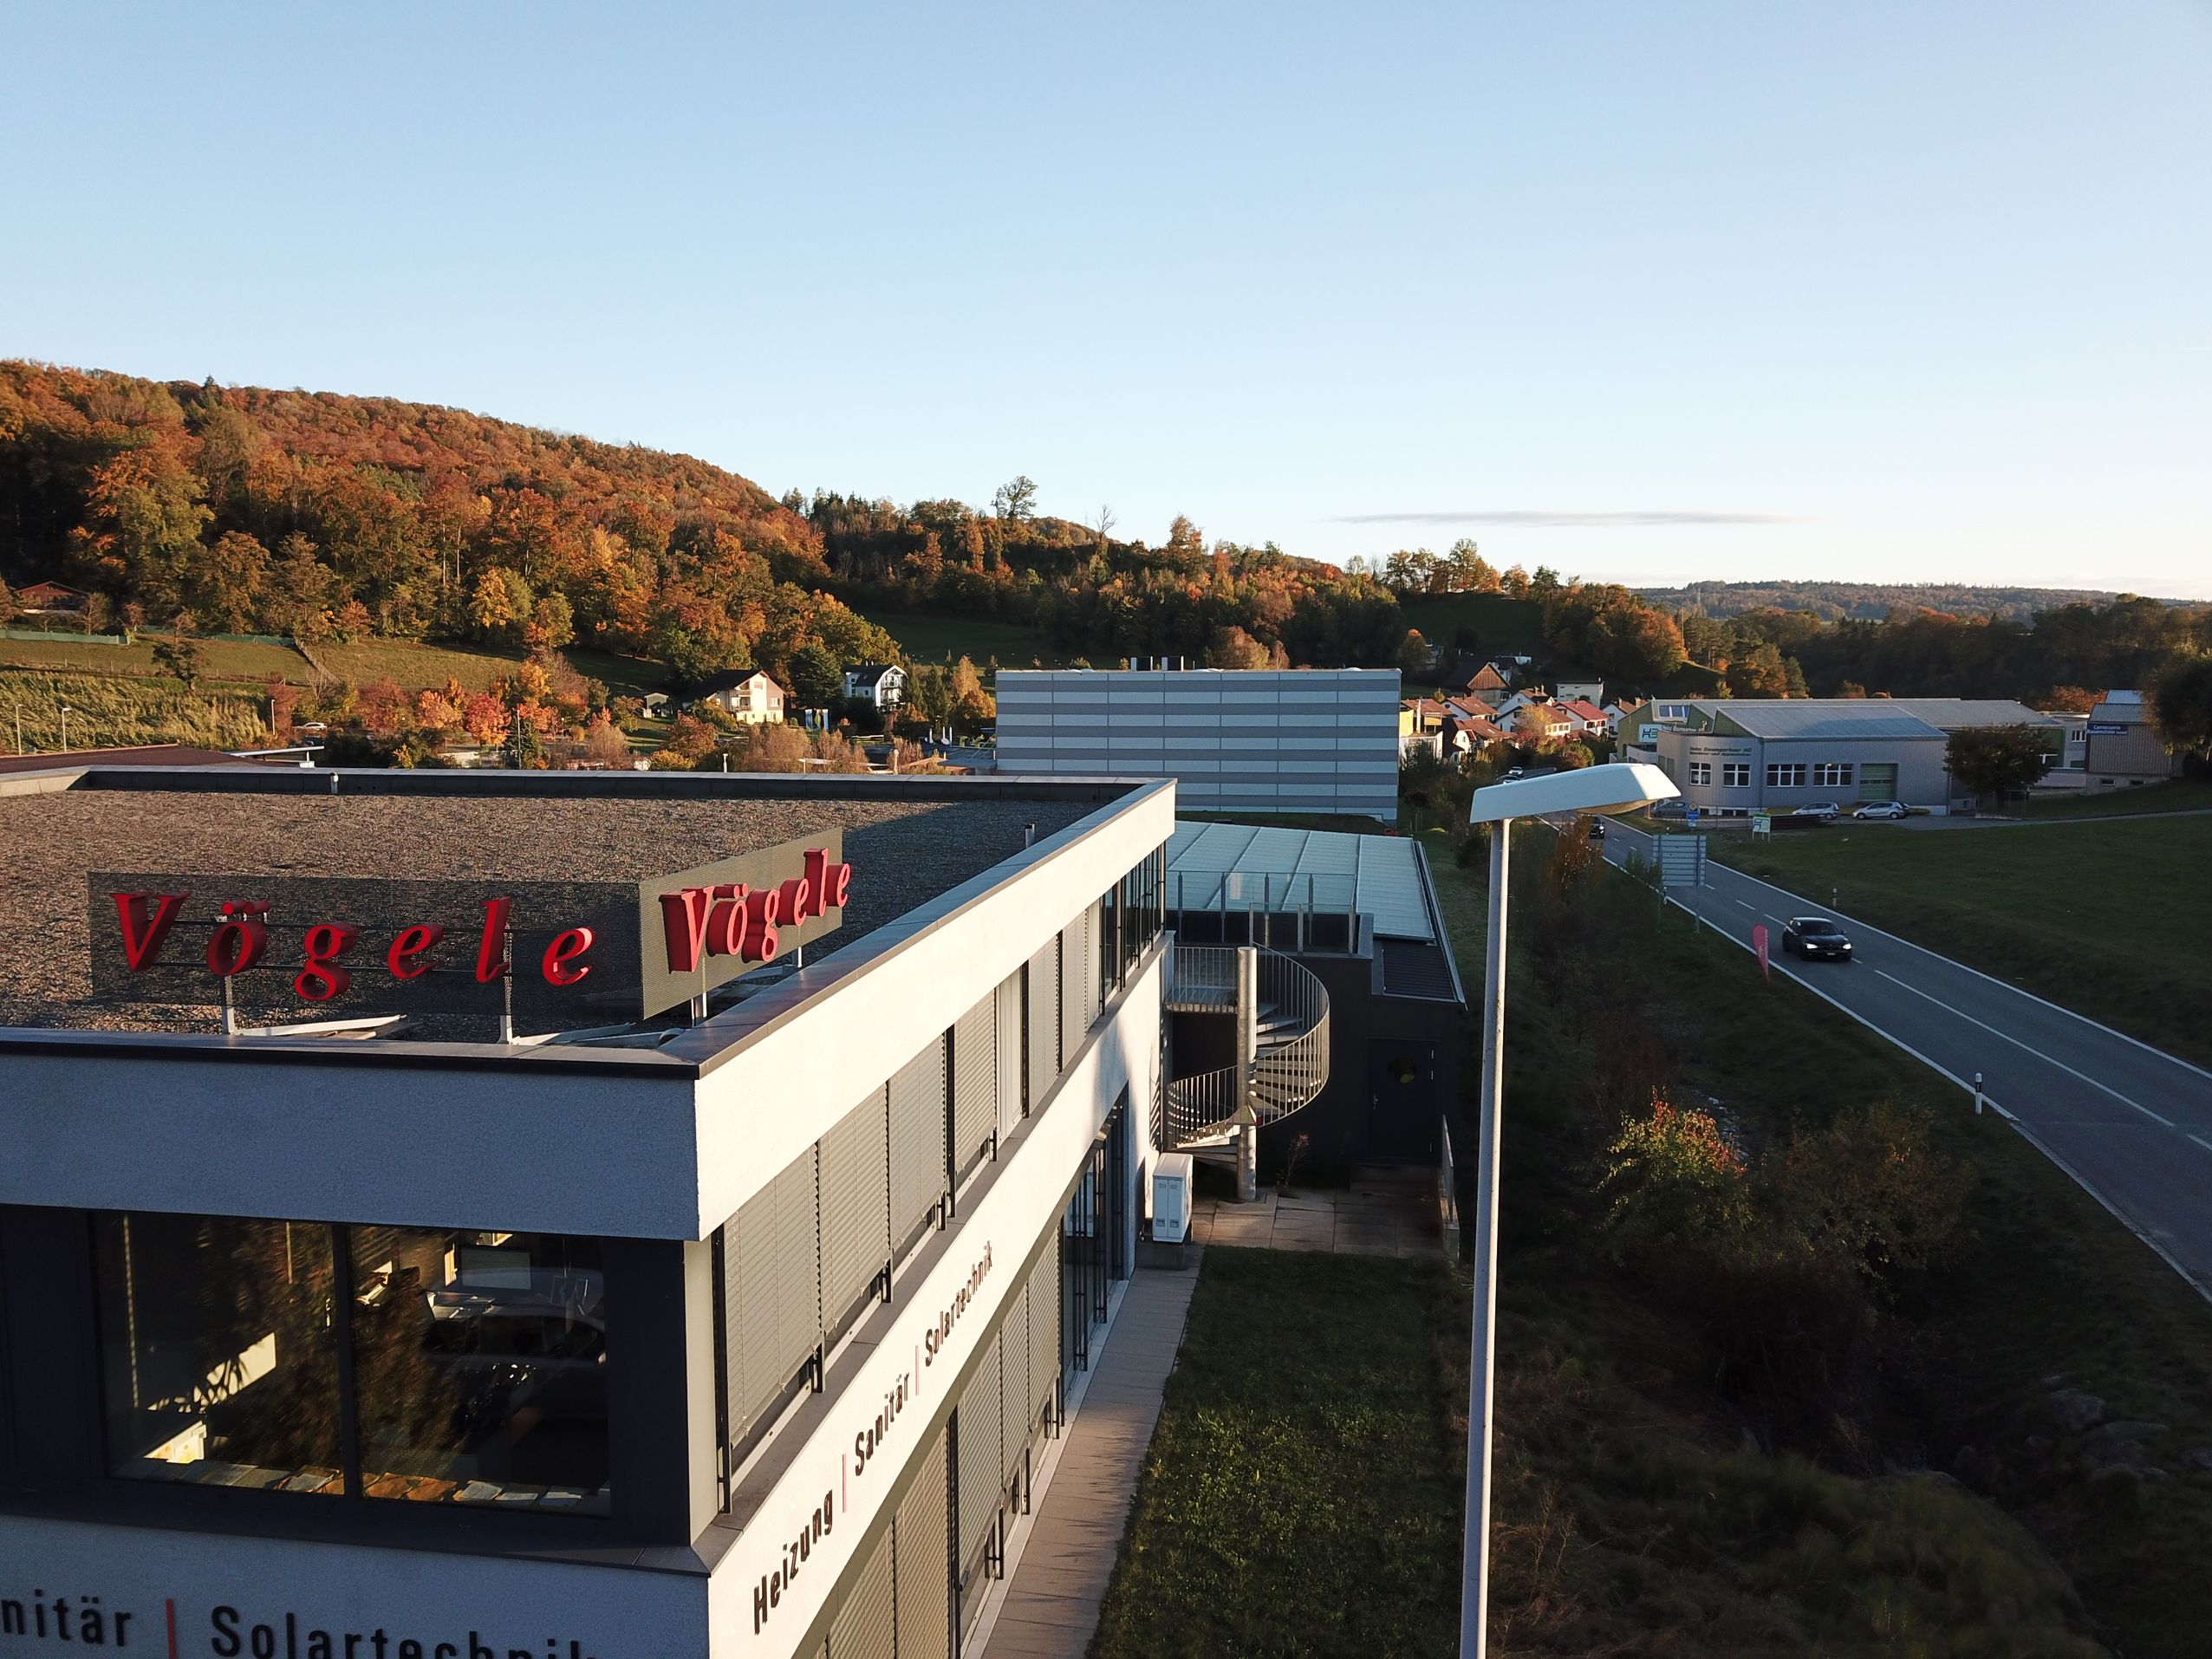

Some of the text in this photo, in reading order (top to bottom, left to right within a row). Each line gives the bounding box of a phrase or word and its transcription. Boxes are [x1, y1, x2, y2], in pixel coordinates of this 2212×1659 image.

[109, 891, 597, 1001] Vögele
[659, 848, 851, 974] Vögele
[753, 1239, 993, 1636] Heizung Sanitär Solartechnik
